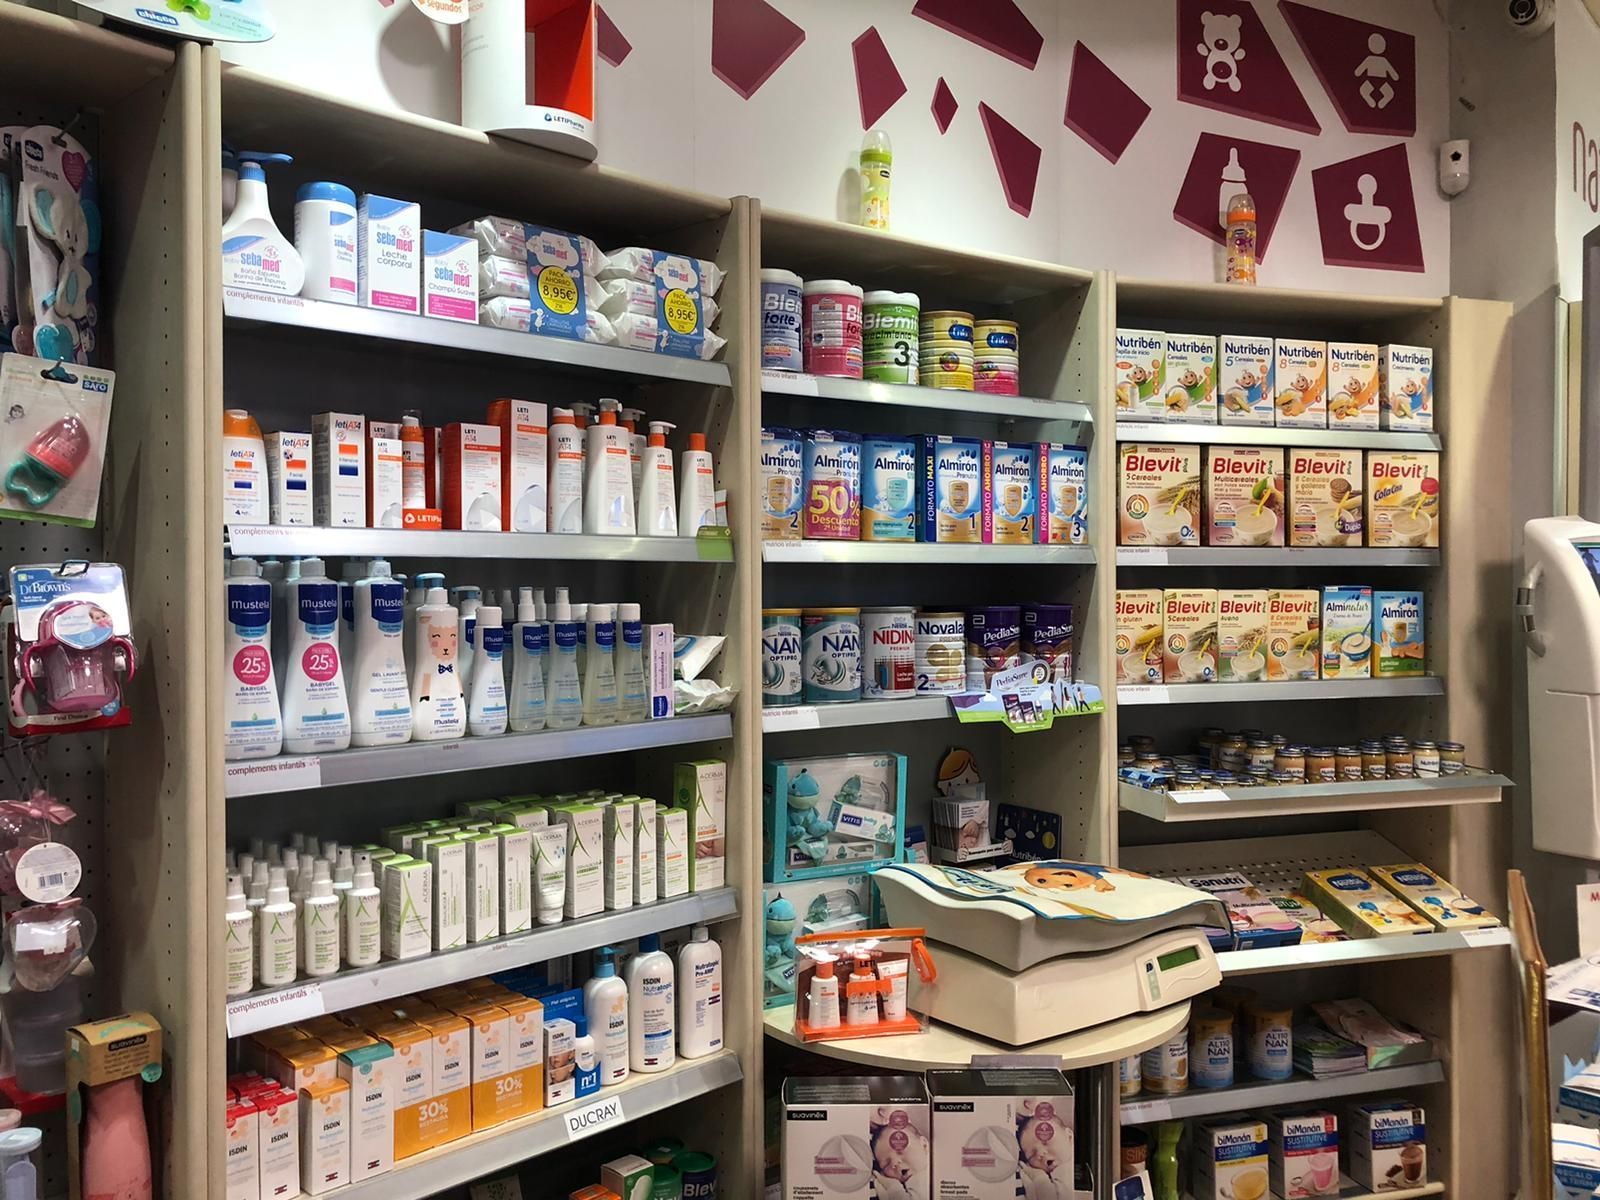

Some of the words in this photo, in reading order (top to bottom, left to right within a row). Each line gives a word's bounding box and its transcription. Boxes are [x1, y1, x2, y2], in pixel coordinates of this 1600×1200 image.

[427, 0, 462, 15] segundos
[376, 230, 415, 253] sebamed
[381, 248, 407, 261] Leche
[240, 251, 281, 273] sebamed
[376, 257, 413, 270] corporal
[434, 266, 472, 288] sebamed
[549, 269, 566, 279] PACK
[545, 275, 571, 288] AHORRO
[226, 288, 276, 304] complements
[277, 297, 305, 308] infantils
[457, 287, 476, 297] Suave
[764, 311, 797, 326] forte
[1116, 335, 1161, 351] Nutribén
[1167, 340, 1213, 355] Nutribén
[1224, 341, 1270, 356] Nutribén
[894, 340, 910, 367] 3
[1279, 345, 1323, 360] Nutribén
[1331, 348, 1375, 362] Nutribén
[1391, 351, 1431, 366] Nutribén
[1225, 355, 1234, 367] 5
[1279, 358, 1287, 370] 8
[1331, 361, 1339, 372] 8
[814, 453, 859, 470] Almirón
[926, 455, 935, 480] MAXI
[938, 458, 978, 473] Almirón
[1126, 455, 1181, 473] Blevit
[1213, 457, 1267, 475] Blevit
[1294, 458, 1346, 475] Blevit
[983, 454, 992, 492] AHORRO
[995, 463, 1030, 477] Almirón
[1040, 455, 1048, 493] AHORRO
[1051, 464, 1085, 478] Almirón
[1372, 463, 1423, 479] Blevit
[1214, 475, 1258, 484] Multicereales
[926, 480, 935, 522] FORMATO
[983, 492, 992, 532] FORMATO
[1040, 493, 1048, 532] FORMATO
[790, 510, 799, 530] 2
[810, 514, 859, 527] Descuento
[969, 512, 976, 530] 1
[1020, 516, 1029, 532] 2
[234, 527, 284, 538] complements
[1072, 521, 1081, 538] 3
[231, 598, 270, 611] Mustela
[301, 597, 338, 609] Mustela
[1167, 600, 1210, 614] Blevit
[1220, 600, 1263, 614] Blevit
[1270, 600, 1313, 614] Blevit
[1172, 615, 1200, 623] Cereales
[1380, 605, 1420, 620] Almirón
[918, 620, 965, 637] Novala
[769, 654, 798, 663] OPTIPRO
[831, 651, 857, 660] OPTIPRO
[917, 673, 931, 691] 2
[228, 763, 277, 778] complements
[278, 760, 306, 771] infantils
[841, 813, 863, 826] VITIS
[1189, 875, 1246, 889] Sanutri
[643, 977, 661, 987] ISDIN
[228, 997, 279, 1015] complements
[280, 988, 308, 1003] infantils
[609, 1019, 625, 1030] ISDIN
[519, 1040, 534, 1050] ISDIN
[484, 1050, 499, 1060] ISDIN
[444, 1061, 460, 1072] ISDIN
[405, 1072, 422, 1083] ISDIN
[495, 1076, 524, 1097] 30%
[365, 1091, 383, 1103] ISDIN
[418, 1101, 449, 1121] 30%
[569, 1103, 618, 1132] DUCRAY
[323, 1120, 341, 1132] ISDIN
[1286, 1122, 1321, 1135] biManán
[1373, 1116, 1409, 1129] biManán
[271, 1131, 289, 1144] ISDIN
[1216, 1132, 1252, 1146] biManán
[229, 1144, 248, 1157] ISDIN
